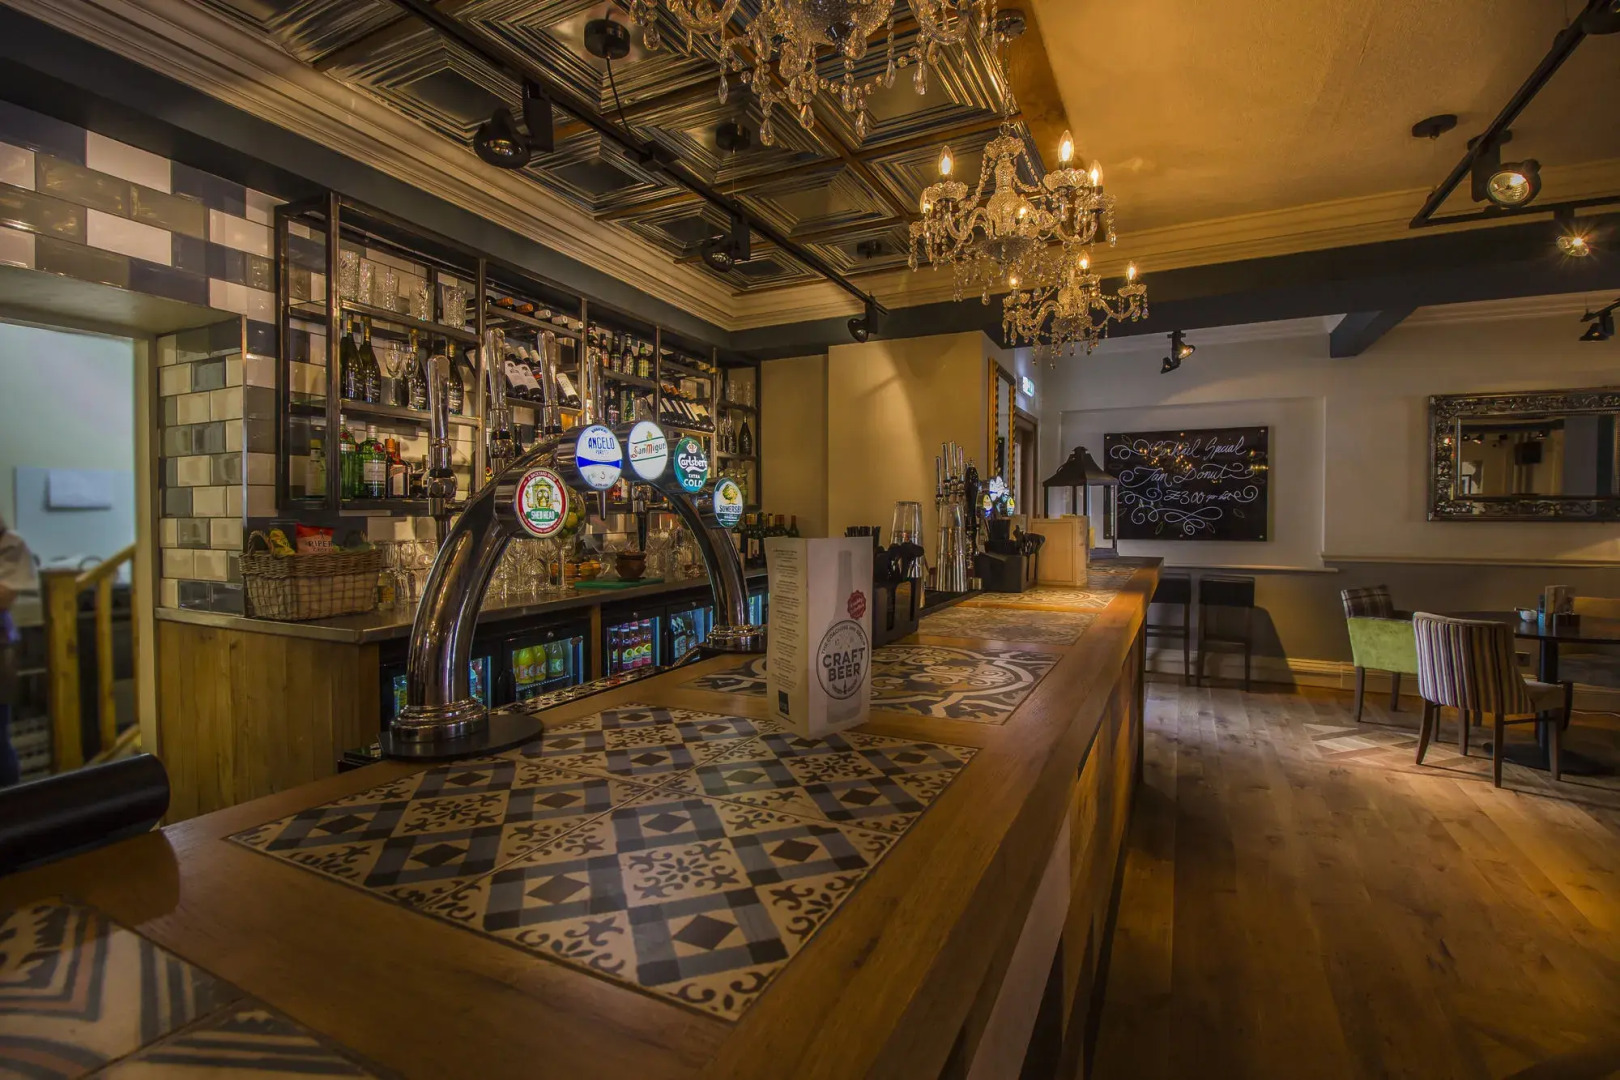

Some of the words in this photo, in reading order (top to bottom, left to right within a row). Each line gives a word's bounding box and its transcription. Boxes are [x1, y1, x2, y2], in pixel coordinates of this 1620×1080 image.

[588, 437, 615, 450] ANGELO
[683, 479, 703, 487] COLD
[542, 511, 555, 520] HEAD
[823, 648, 865, 669] CRAFT
[829, 663, 861, 683] BEER
